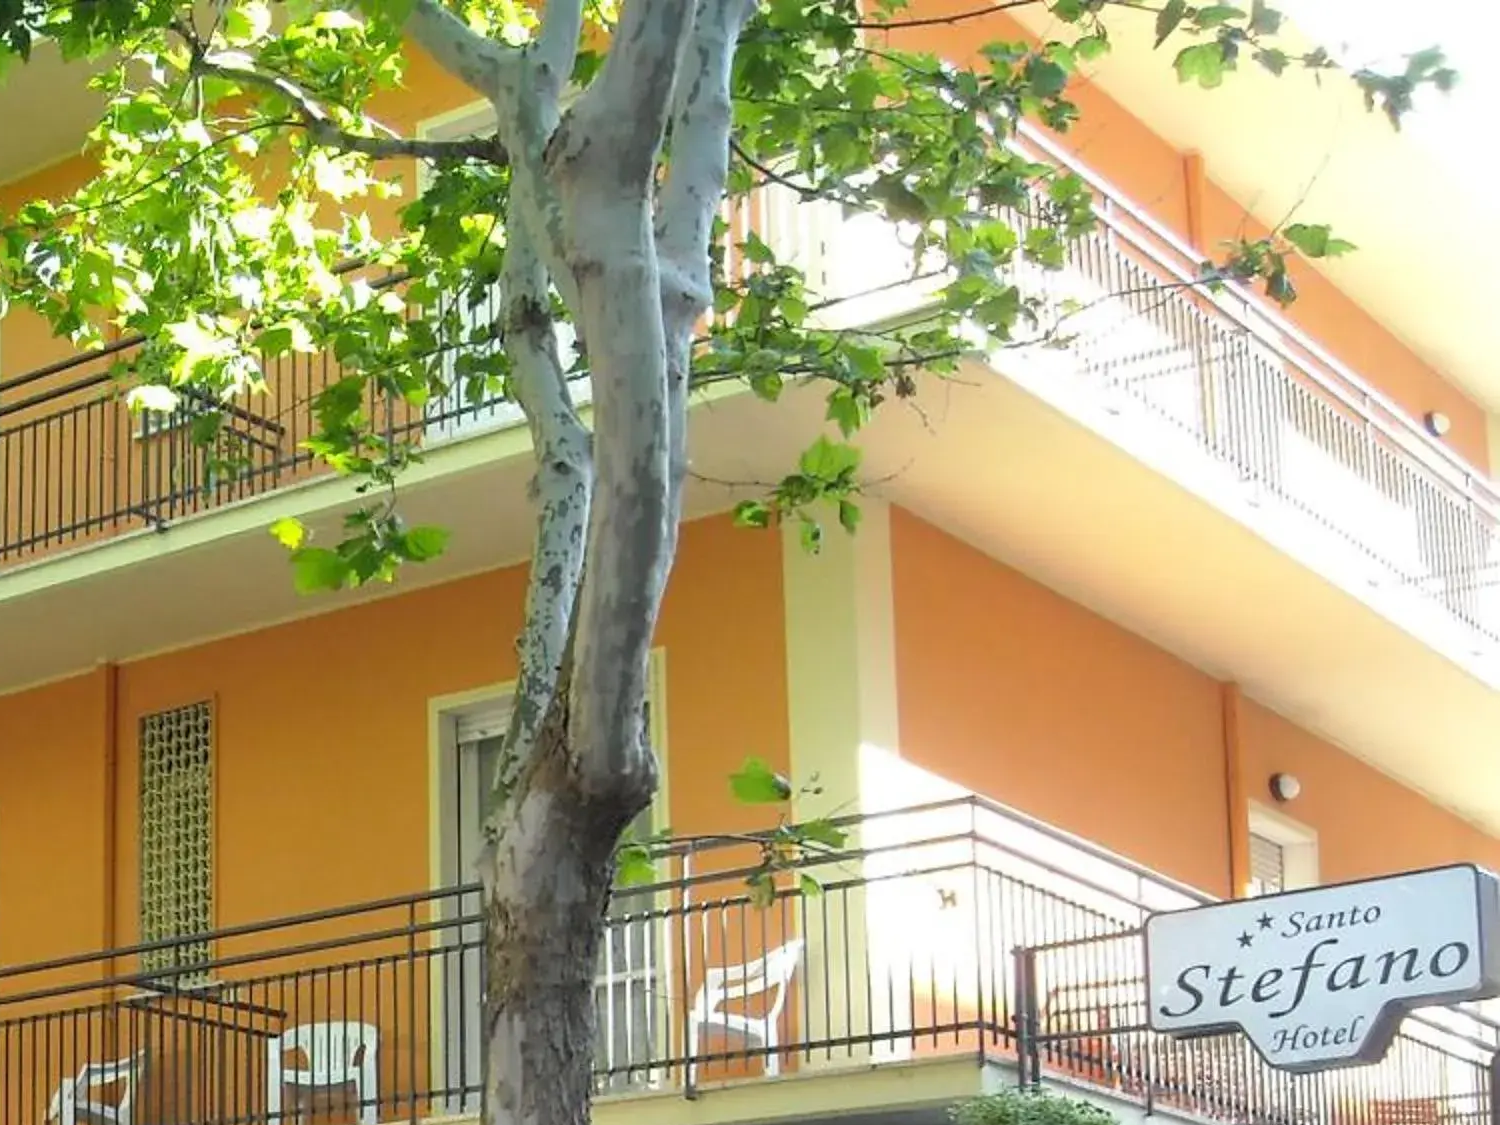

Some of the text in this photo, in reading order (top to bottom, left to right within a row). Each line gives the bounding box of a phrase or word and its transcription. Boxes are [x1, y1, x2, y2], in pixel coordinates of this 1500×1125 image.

[1281, 905, 1381, 938] Santo
[1159, 938, 1470, 1018] Stefano
[1273, 1016, 1365, 1053] Hotel
